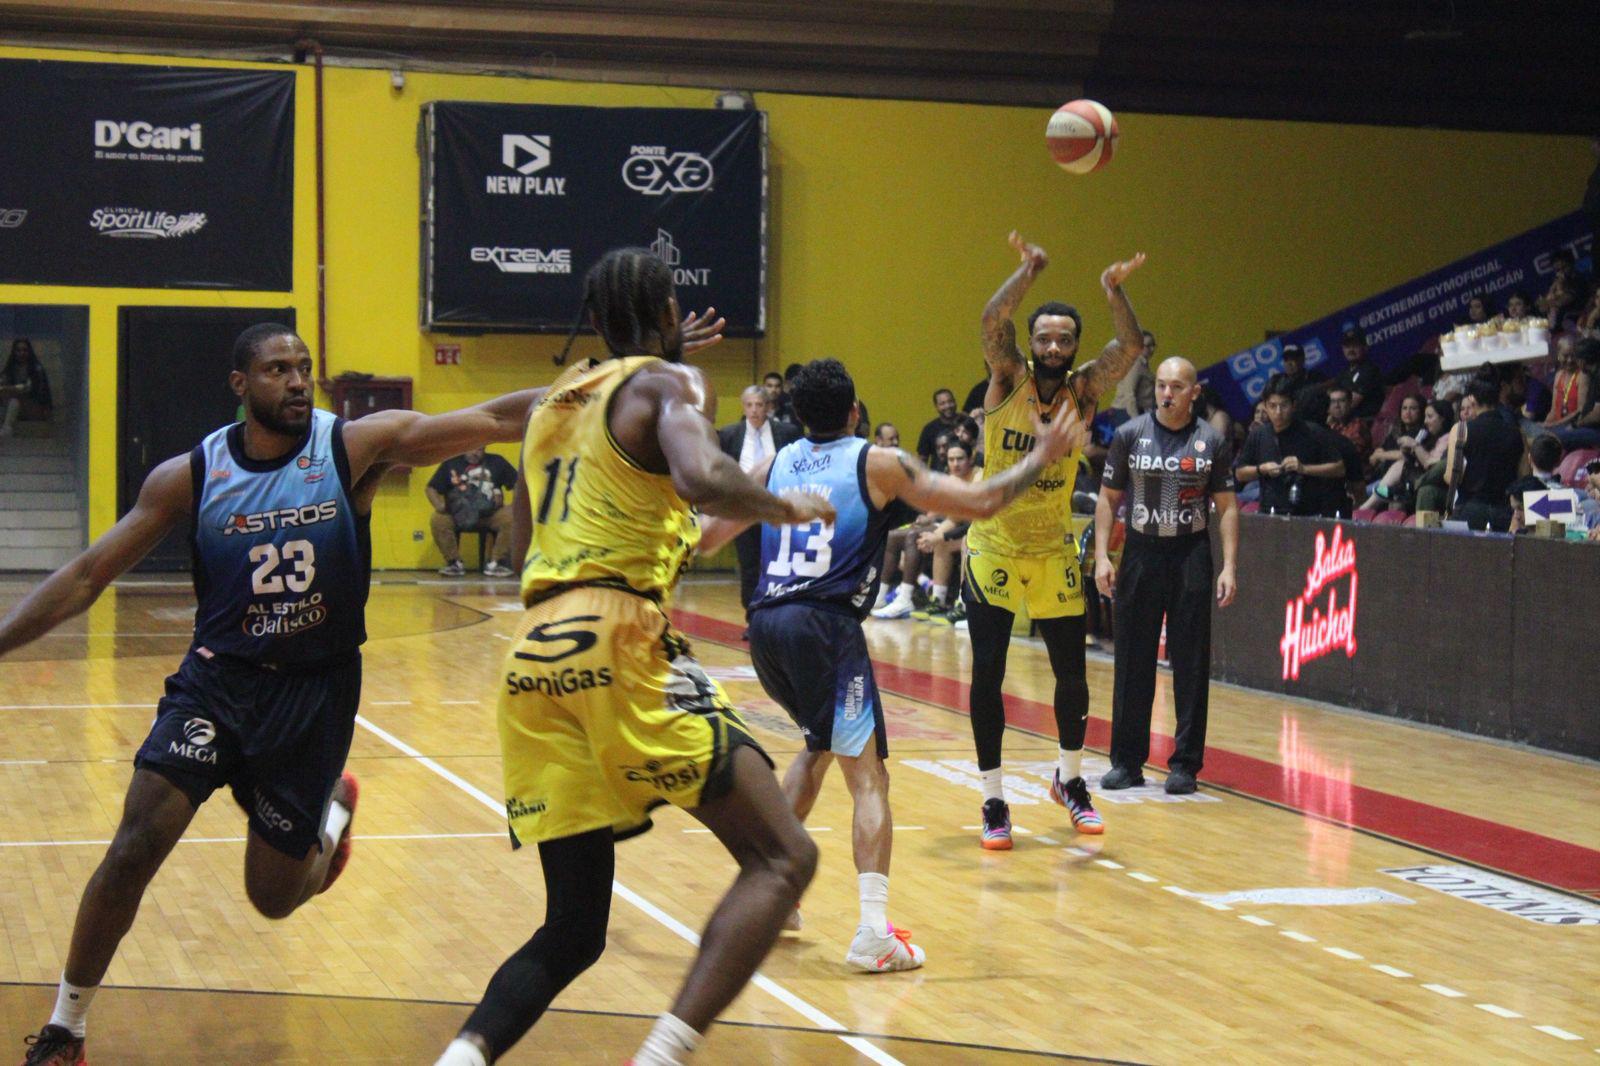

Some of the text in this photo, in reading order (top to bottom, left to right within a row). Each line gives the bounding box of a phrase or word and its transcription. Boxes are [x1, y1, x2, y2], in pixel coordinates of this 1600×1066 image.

[95, 121, 202, 150] D'Gari
[105, 152, 127, 160] amor
[141, 152, 165, 161] forma
[630, 146, 666, 155] PONTE
[486, 176, 565, 195] NEW PLAY
[622, 153, 713, 195] exa
[90, 209, 177, 230] SportLife
[471, 247, 571, 266] EXTREME
[1366, 311, 1425, 346] EXTREME
[1429, 298, 1458, 319] GYM
[223, 500, 336, 536] ASTROS
[767, 520, 835, 578] 13
[248, 539, 315, 595] 23
[1303, 523, 1356, 603] Salsa
[1065, 566, 1076, 589] 5
[247, 592, 322, 615] AL ESTILO
[983, 584, 1010, 600] MEGA
[1280, 570, 1358, 680] Huichol
[507, 666, 613, 697] SoniGas
[168, 740, 217, 765] MEGA
